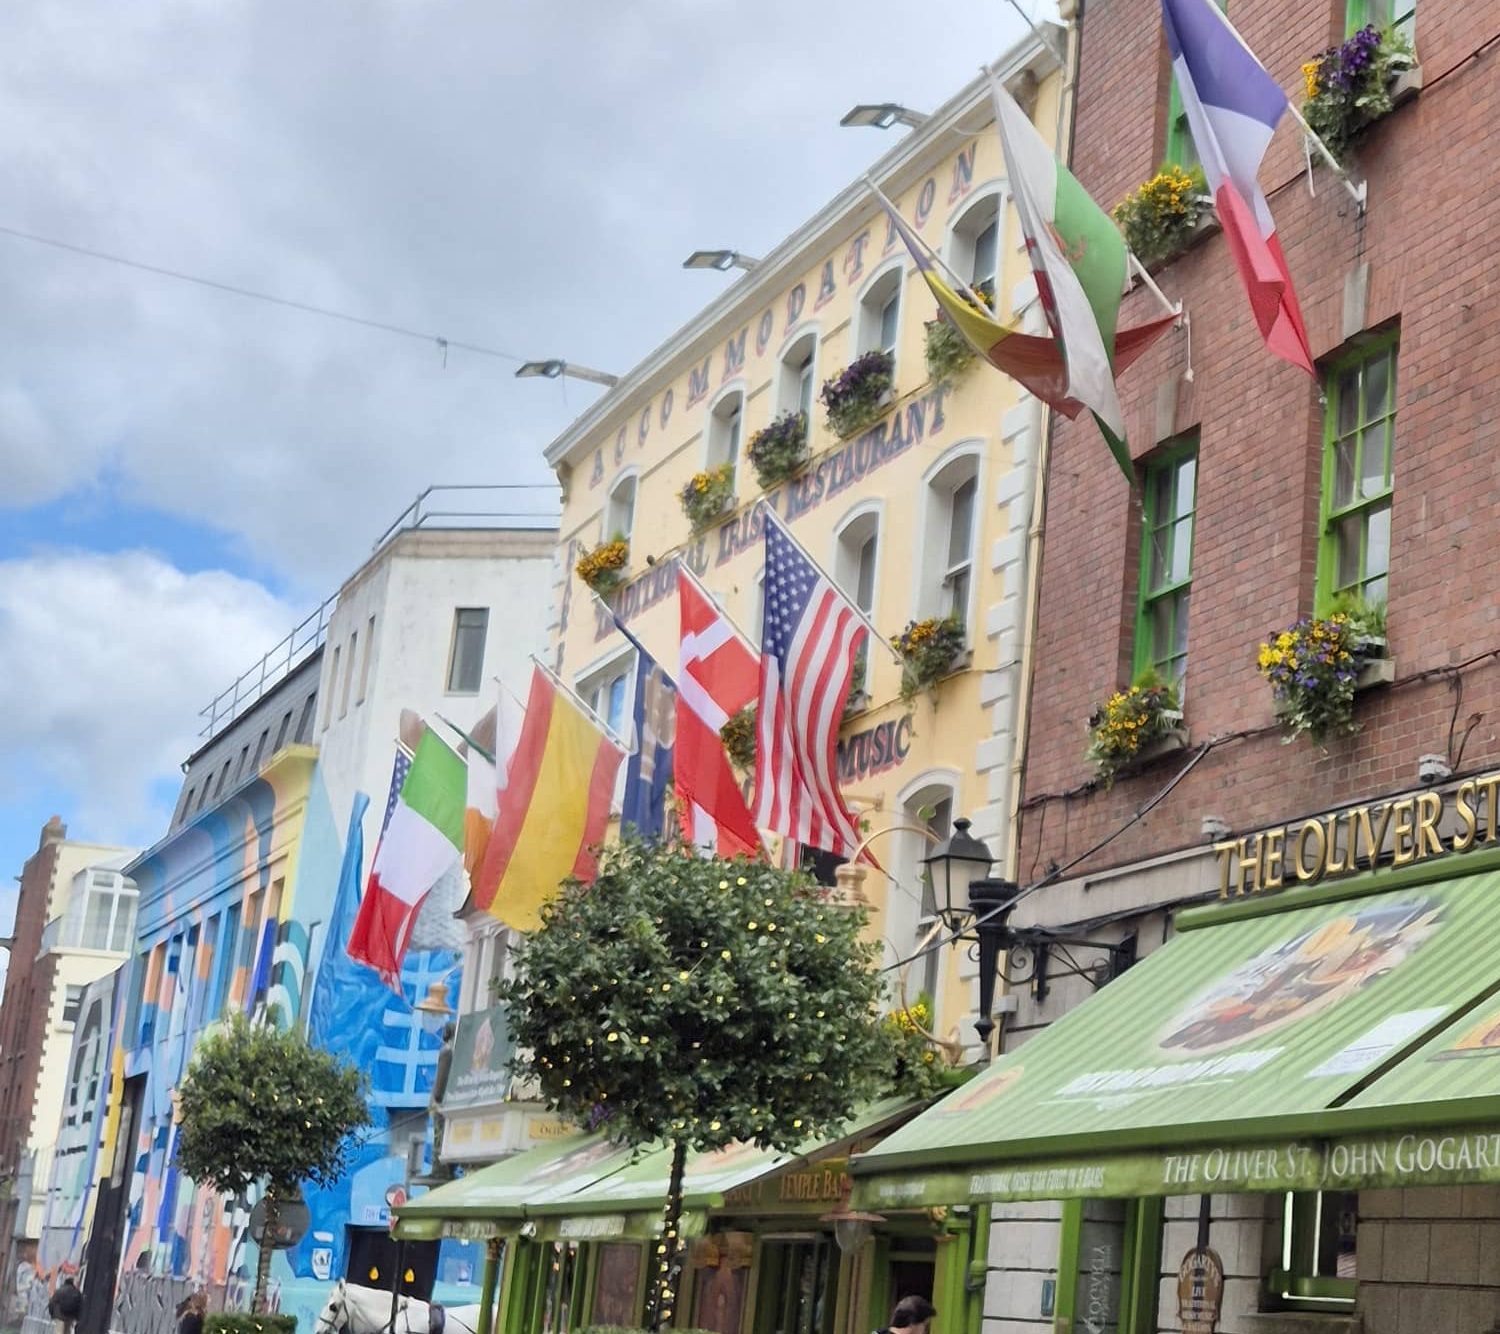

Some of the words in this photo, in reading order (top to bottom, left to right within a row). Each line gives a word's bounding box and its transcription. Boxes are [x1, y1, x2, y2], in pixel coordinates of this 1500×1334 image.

[589, 142, 978, 489] ACCOMMODATION
[784, 385, 952, 524] RESTAURANT
[837, 714, 913, 784] MUSIC
[1214, 828, 1284, 899] THE
[1294, 791, 1444, 883] OLIVER
[780, 1172, 820, 1199] TEMPLE
[1163, 1154, 1201, 1183] THE
[1203, 1148, 1278, 1182] OLIVER
[1320, 1141, 1389, 1184] JOHN
